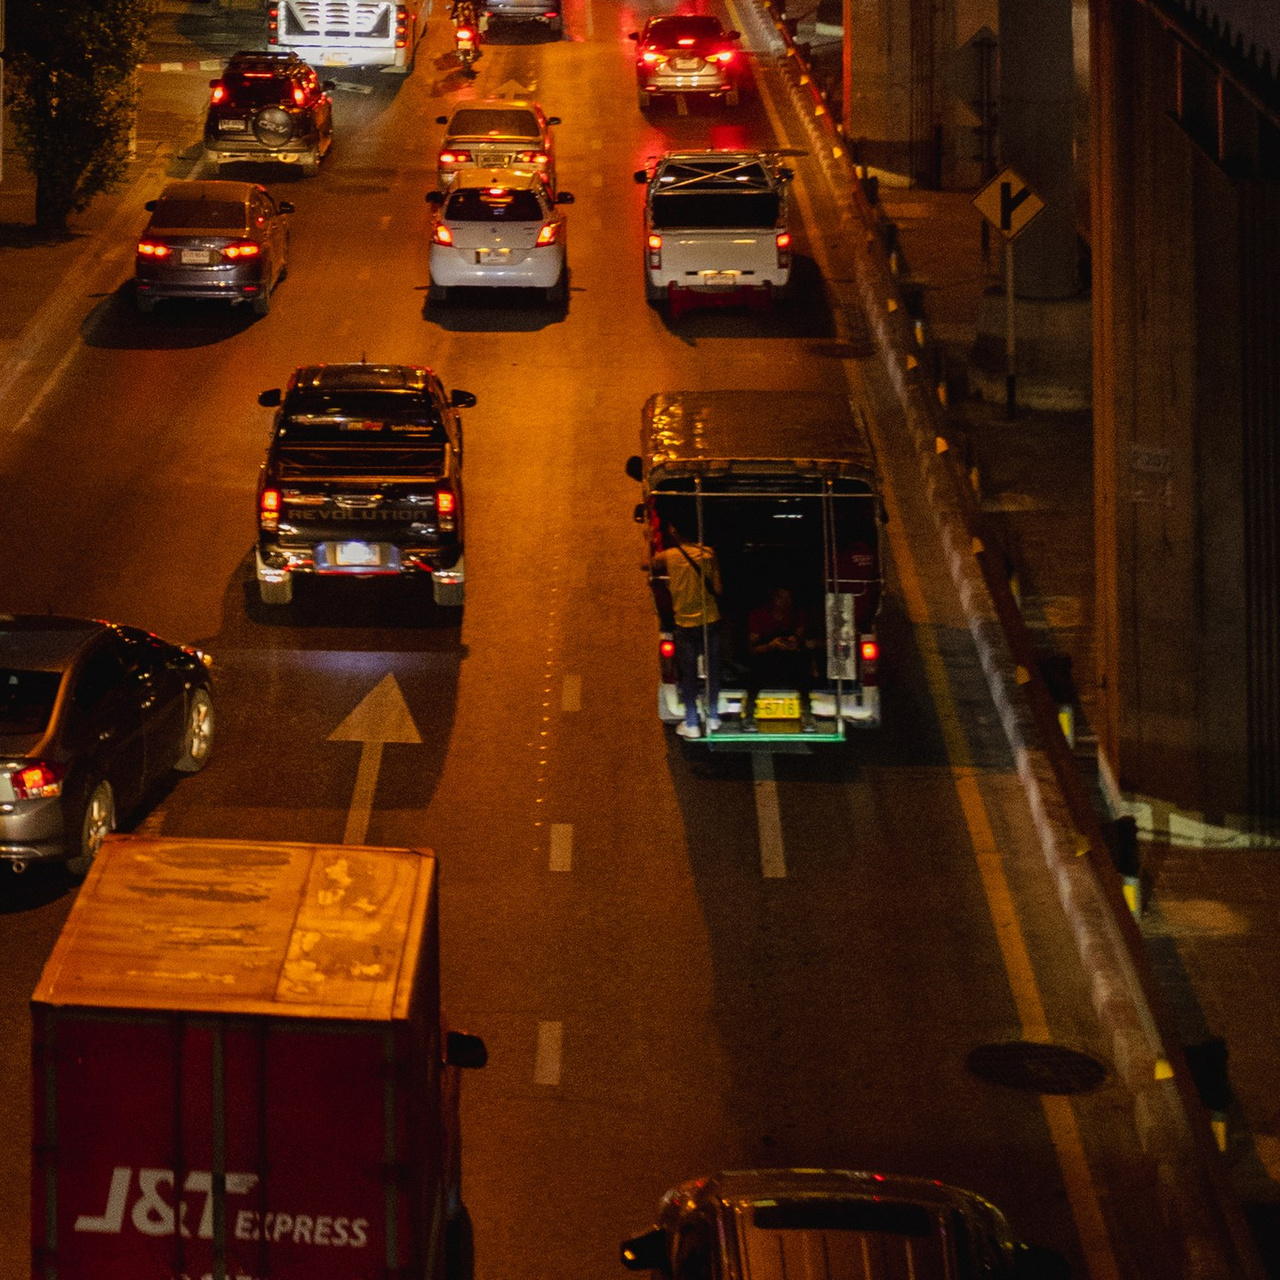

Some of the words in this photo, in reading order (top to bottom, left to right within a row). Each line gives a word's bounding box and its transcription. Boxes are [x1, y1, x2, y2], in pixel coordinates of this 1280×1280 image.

[286, 508, 428, 521] REVOLUTION
[73, 1165, 260, 1239] J&T
[233, 1210, 370, 1249] EXPRESS
